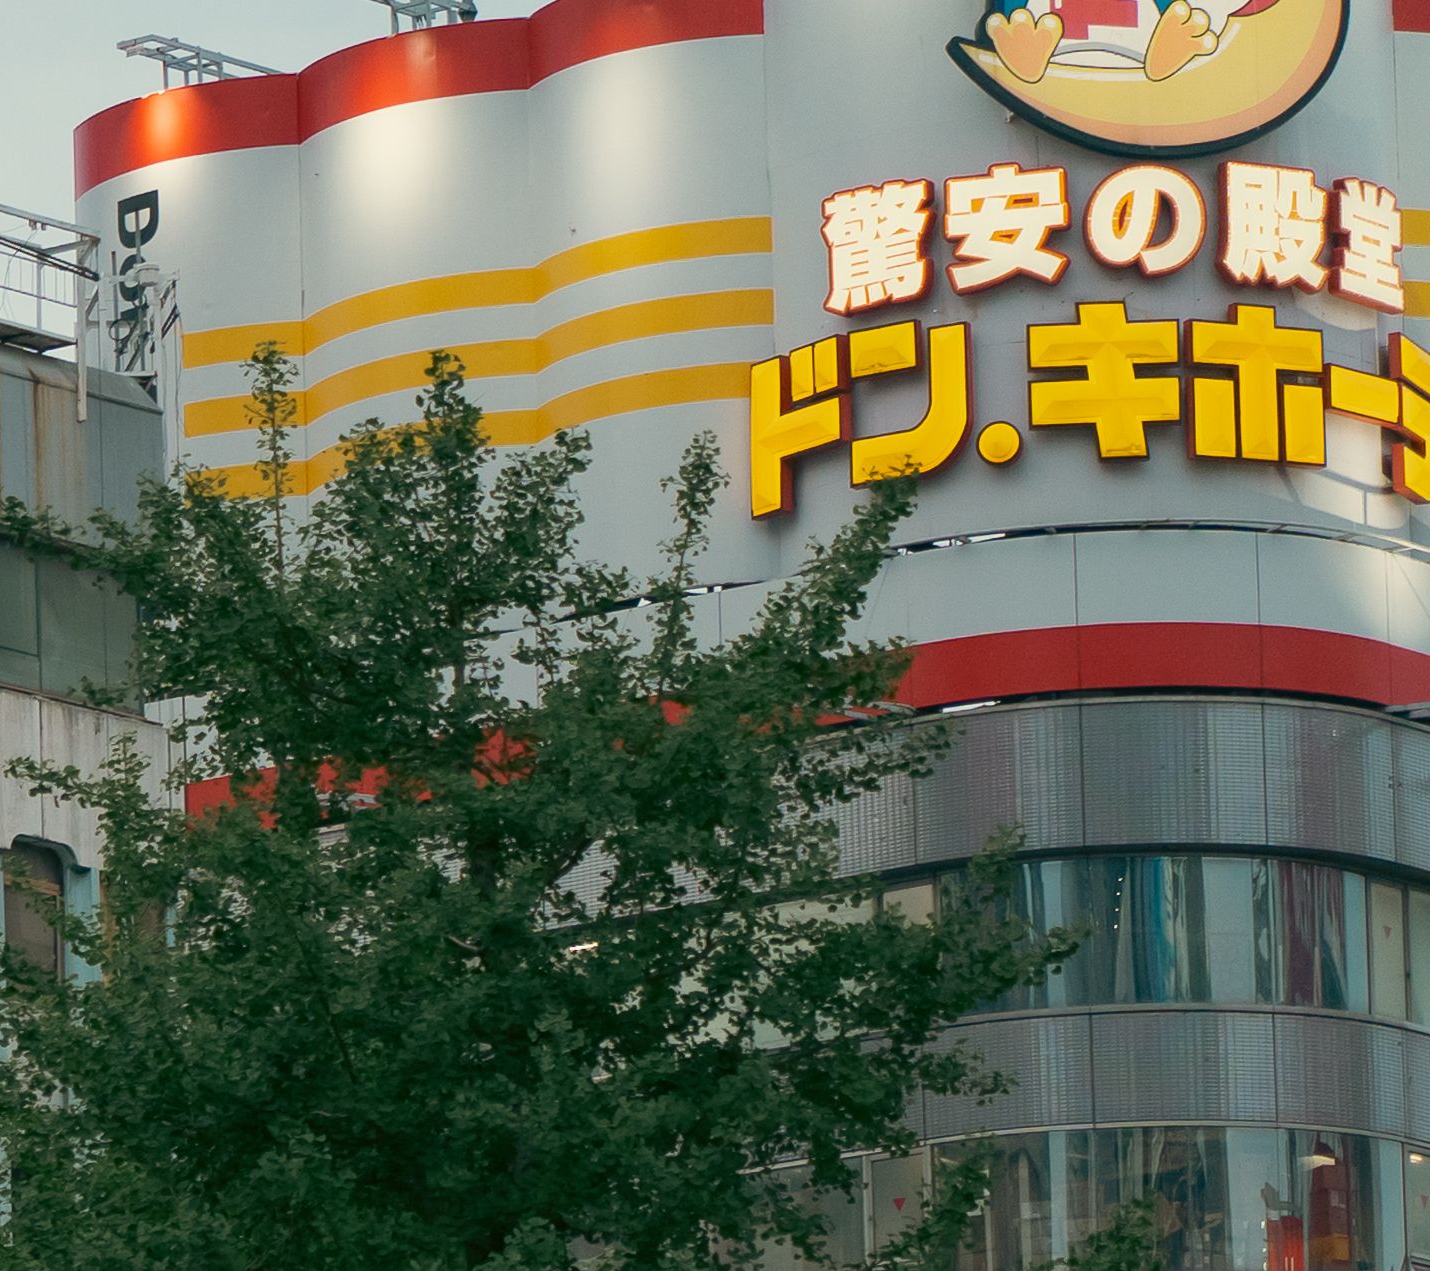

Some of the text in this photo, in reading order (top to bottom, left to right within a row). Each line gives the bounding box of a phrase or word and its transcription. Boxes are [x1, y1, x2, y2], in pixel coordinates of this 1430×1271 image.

[823, 163, 1401, 316] 驚安の殿堂
